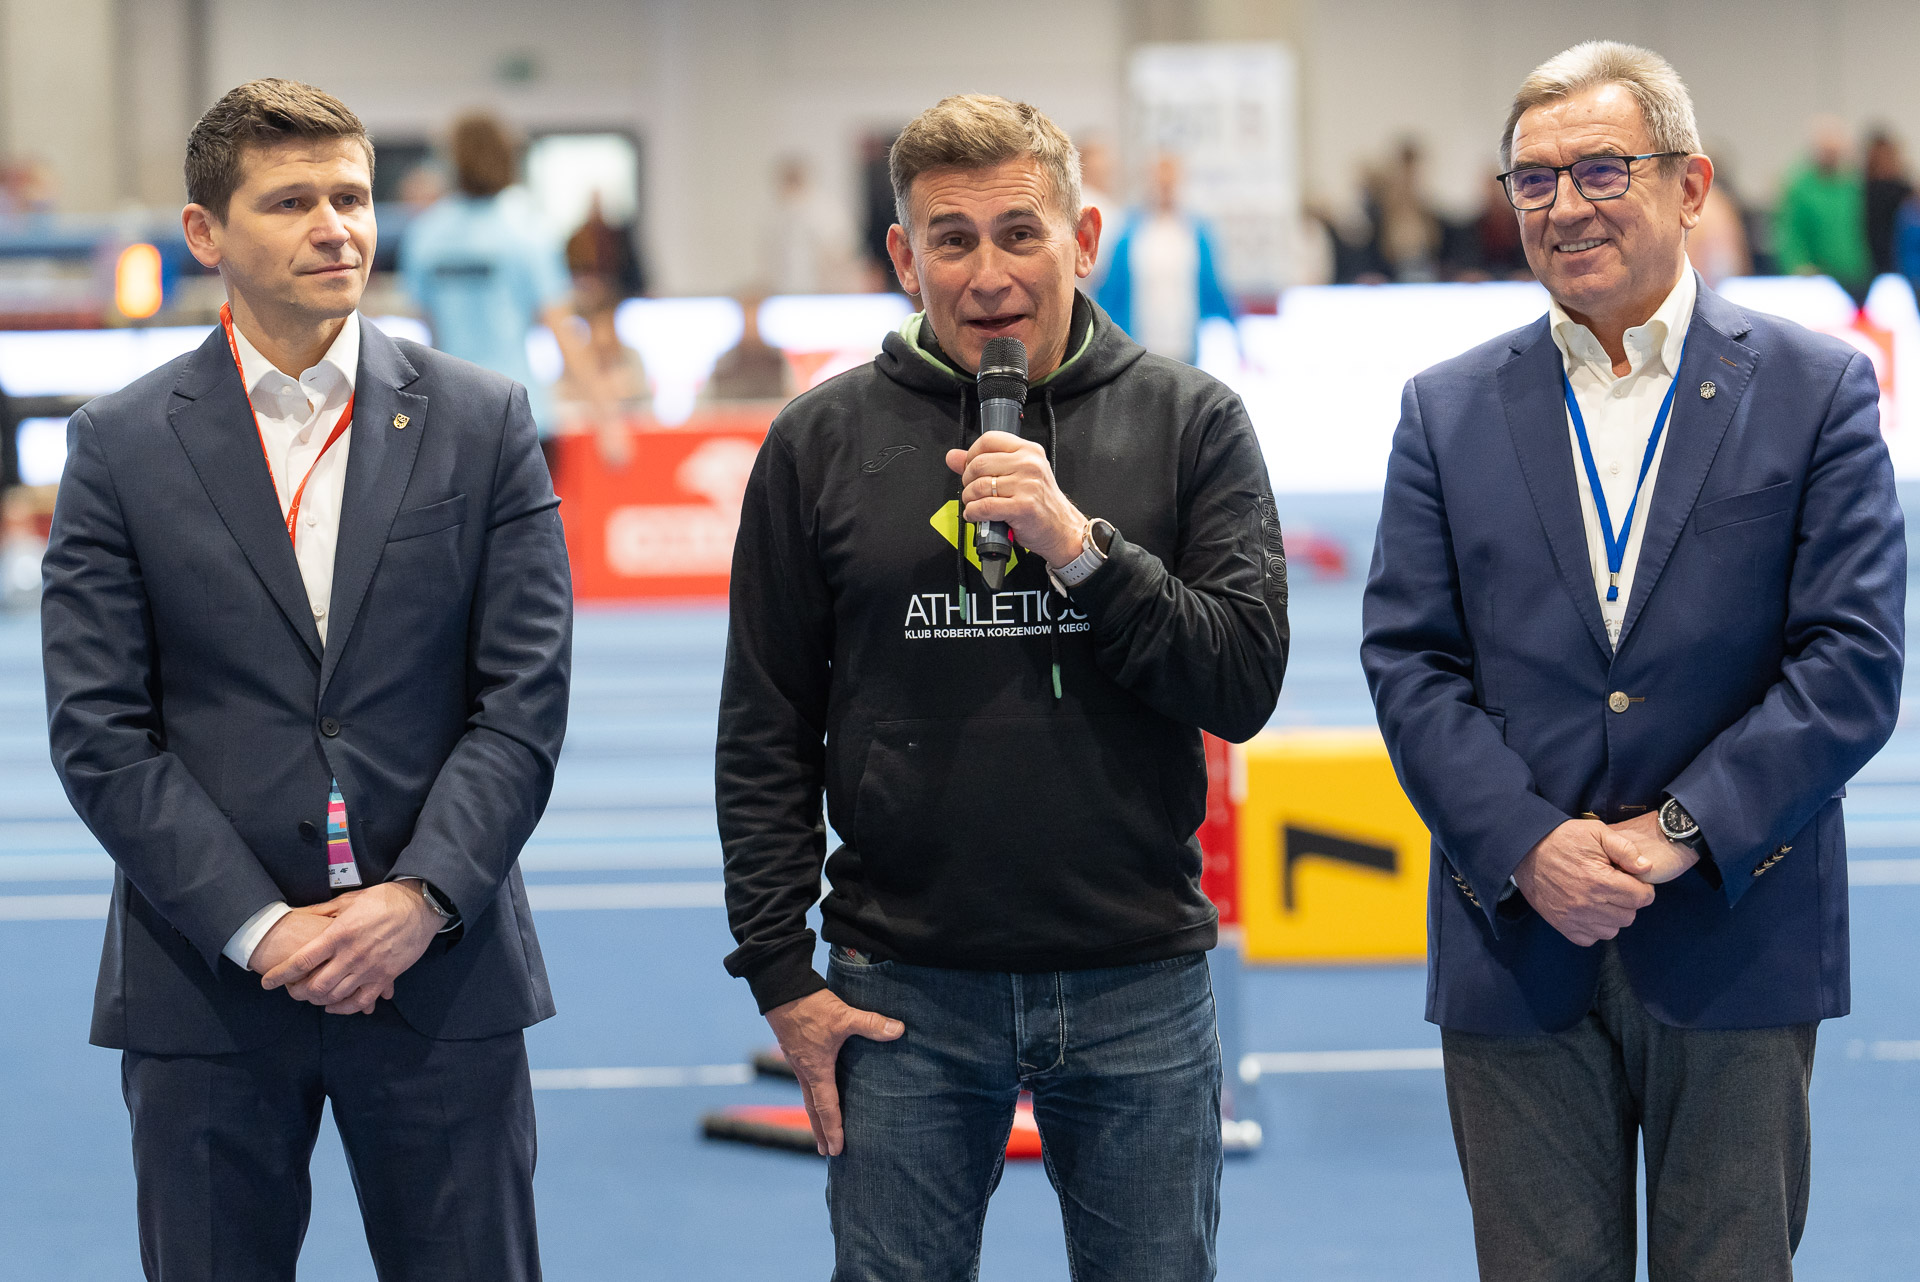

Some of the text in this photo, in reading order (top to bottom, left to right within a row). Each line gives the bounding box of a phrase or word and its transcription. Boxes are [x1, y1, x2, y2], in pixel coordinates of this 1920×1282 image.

[904, 622, 1091, 639] KLUB ROBERTA KORZENIOWKIEGO
